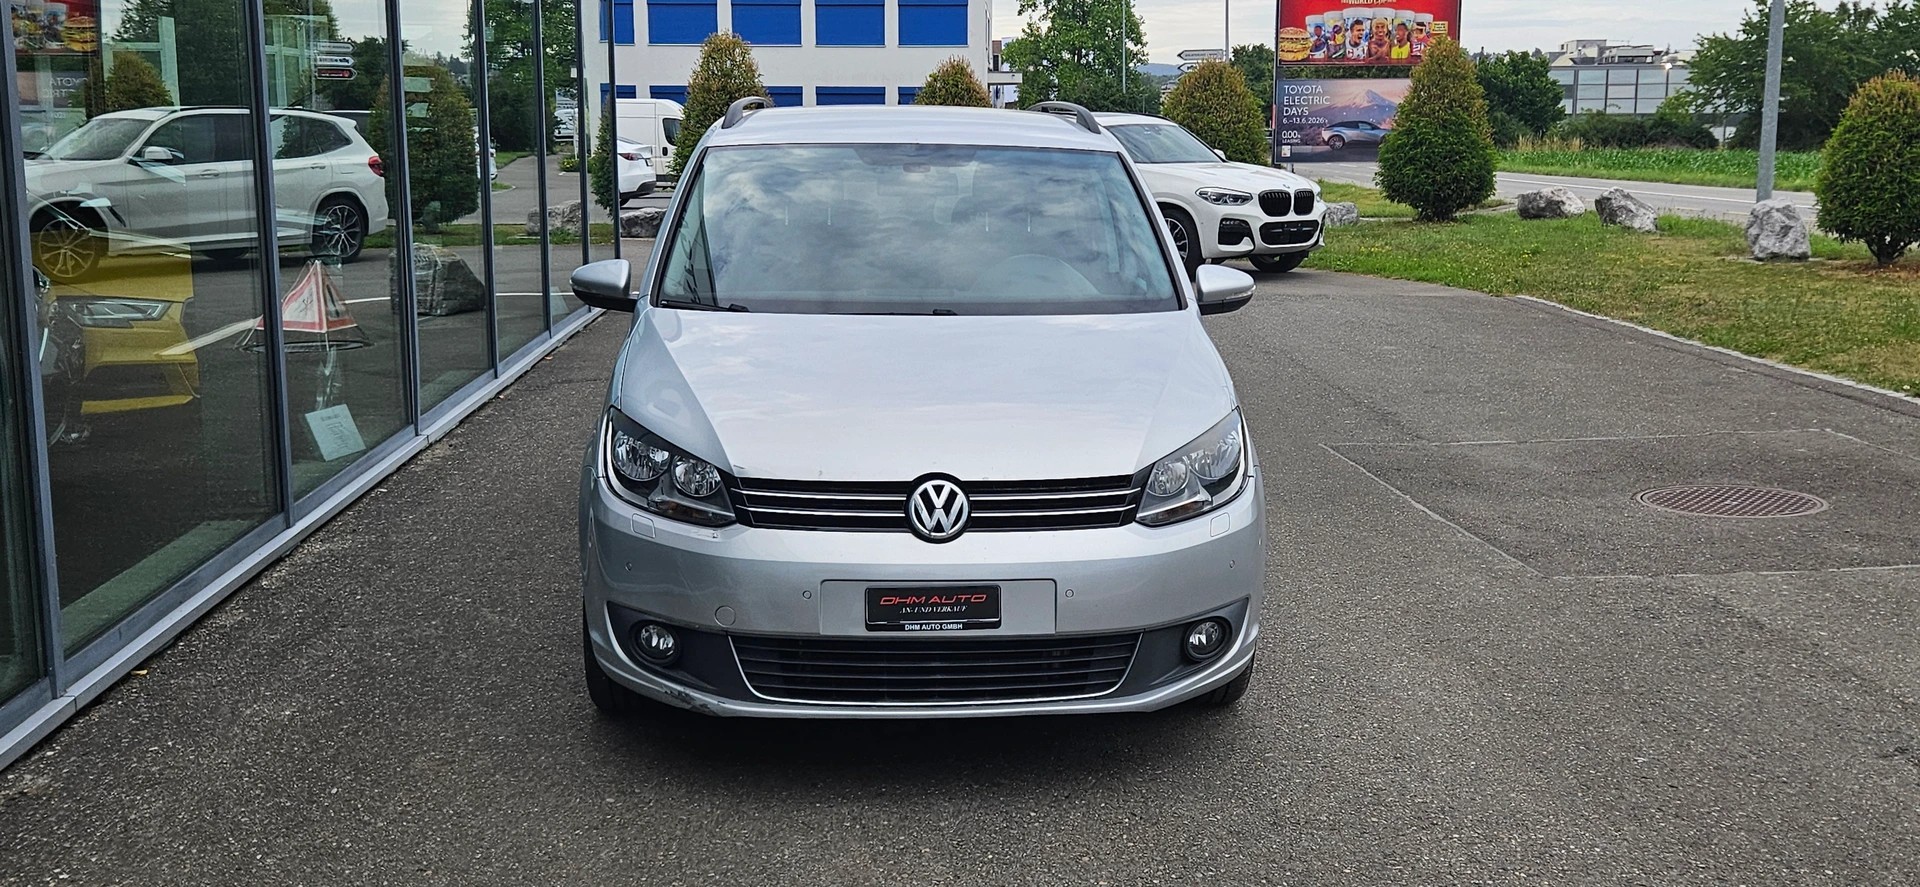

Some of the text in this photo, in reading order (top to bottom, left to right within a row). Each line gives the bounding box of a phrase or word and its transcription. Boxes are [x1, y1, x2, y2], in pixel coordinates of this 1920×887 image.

[1283, 85, 1323, 94] TOYOTA
[1283, 96, 1331, 105] ELECTRIC
[1283, 107, 1309, 116] DAYS
[910, 480, 967, 537] VW
[880, 594, 987, 605] DHM AUTO
[933, 605, 968, 613] VERKAUF
